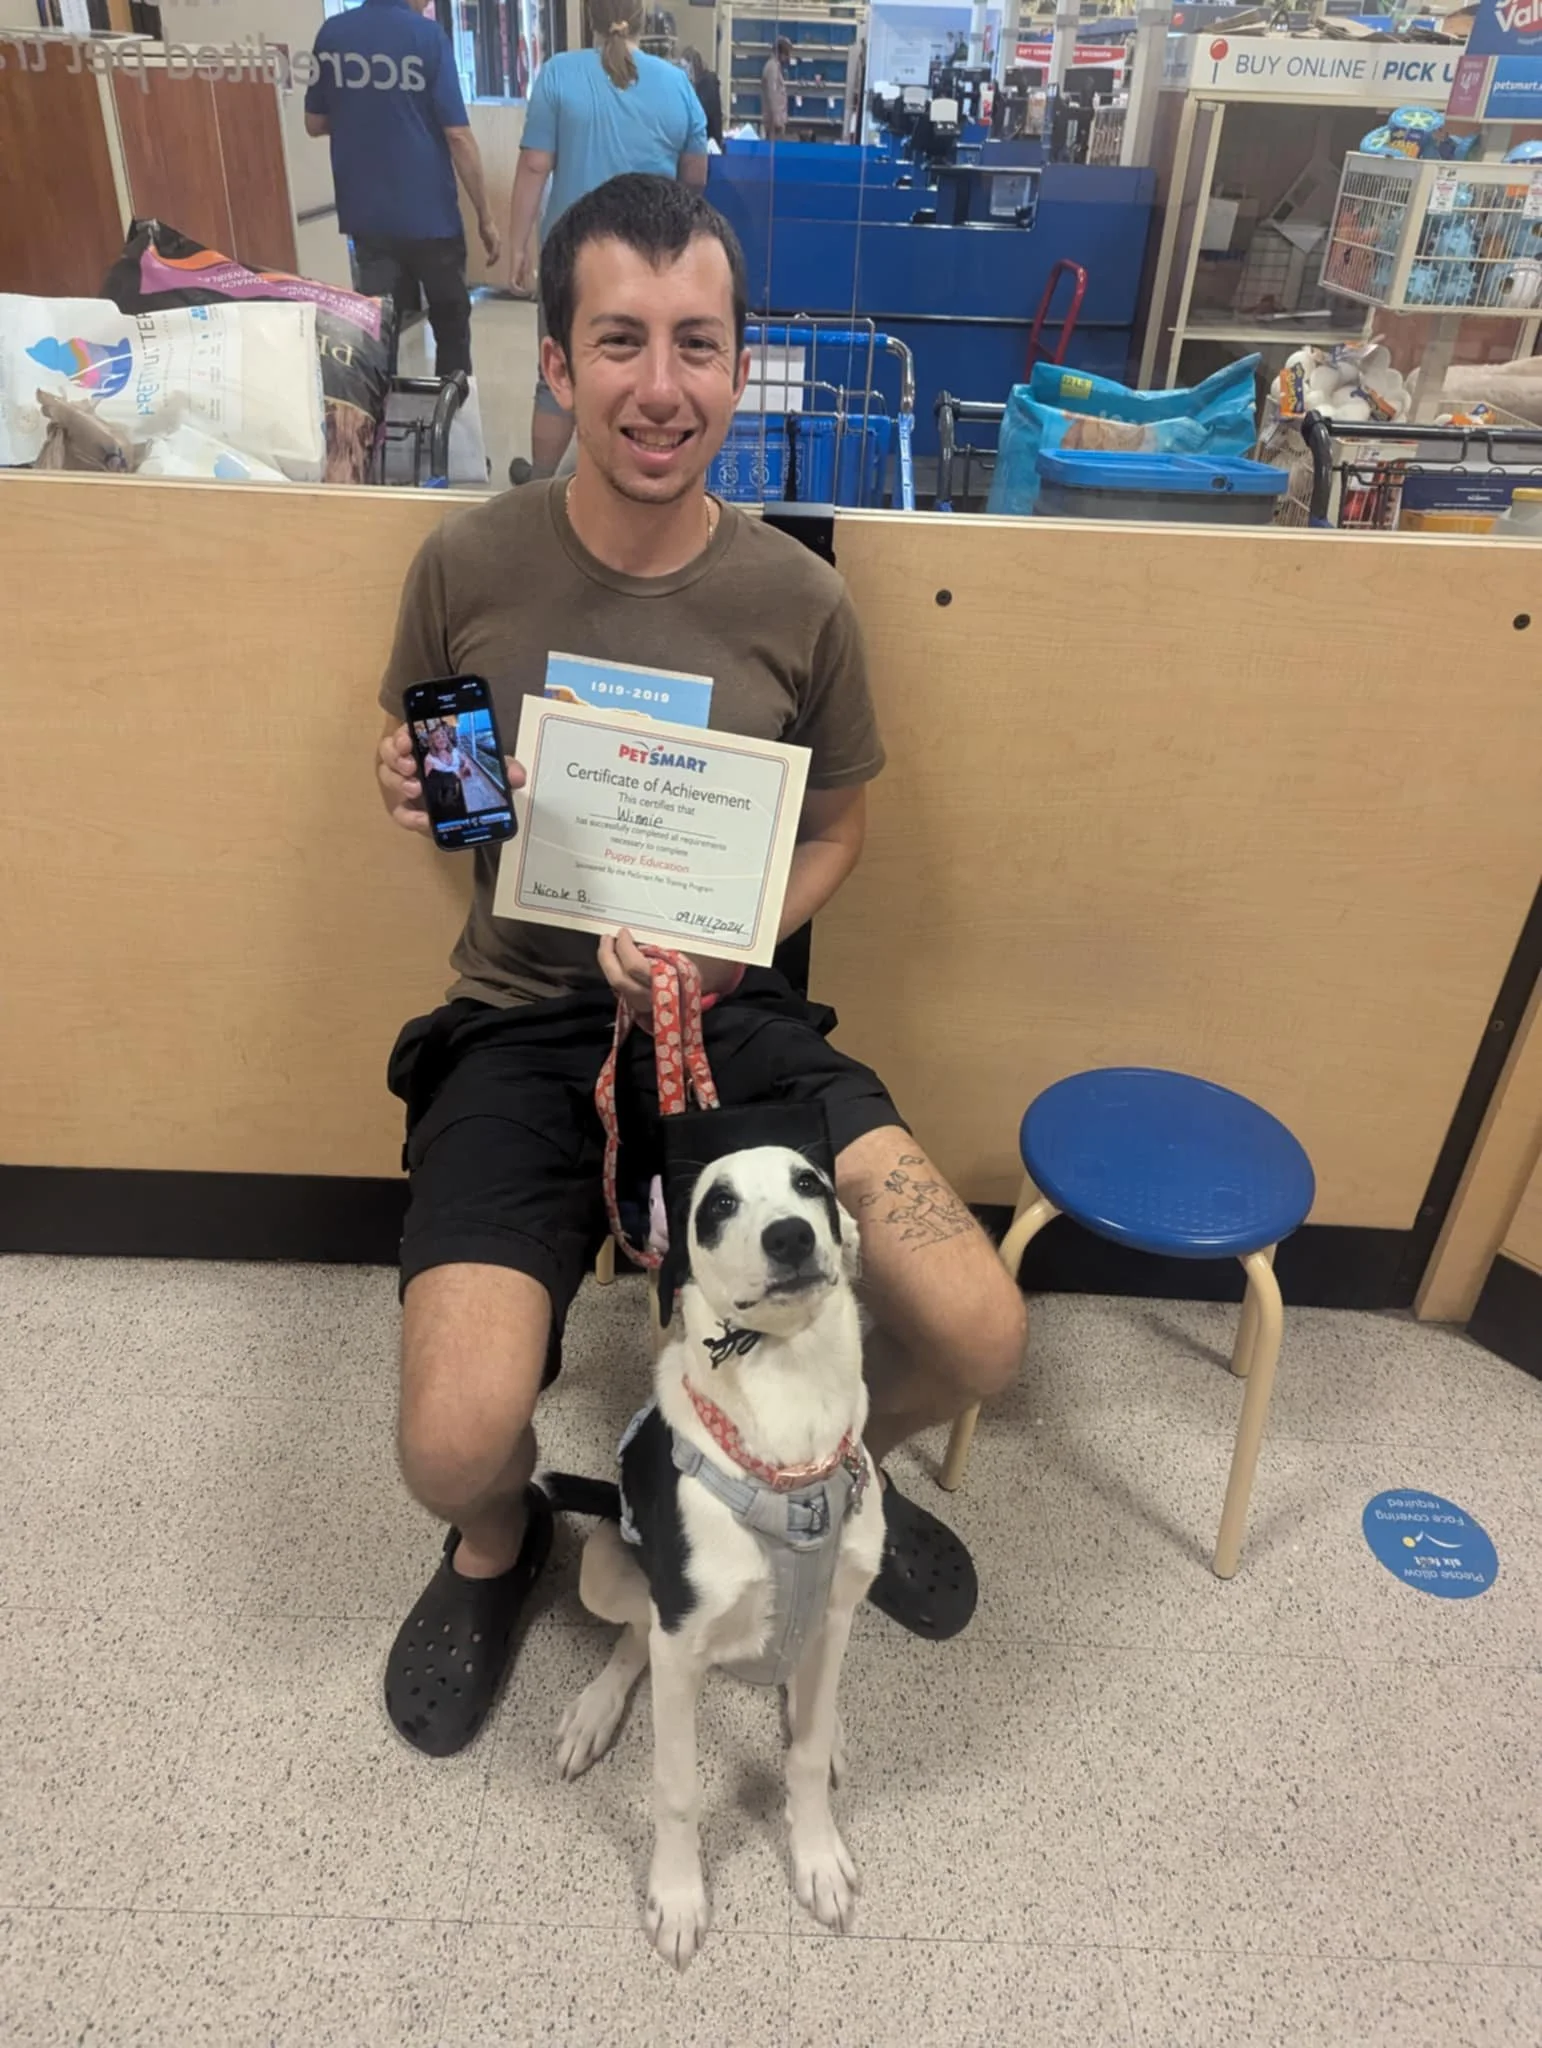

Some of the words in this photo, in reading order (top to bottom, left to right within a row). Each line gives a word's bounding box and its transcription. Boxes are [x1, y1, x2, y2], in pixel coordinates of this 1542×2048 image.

[1494, 0, 1542, 32] Val
[1235, 53, 1282, 75] BUY
[1286, 55, 1366, 81] ONLINE
[1383, 60, 1435, 83] PICK
[591, 680, 670, 704] 1919-2019
[618, 742, 708, 774] PETSMART
[566, 762, 640, 789] Certificate
[643, 777, 660, 793] of
[661, 780, 752, 811] Achievement
[617, 791, 637, 805] This
[638, 794, 675, 812] certifies
[677, 803, 696, 816] that
[604, 847, 637, 866] Puppy
[639, 854, 690, 873] Education
[1374, 1509, 1430, 1523] covering
[1386, 1498, 1440, 1509] required
[1432, 1514, 1465, 1526] Face
[1441, 1570, 1485, 1583] Please
